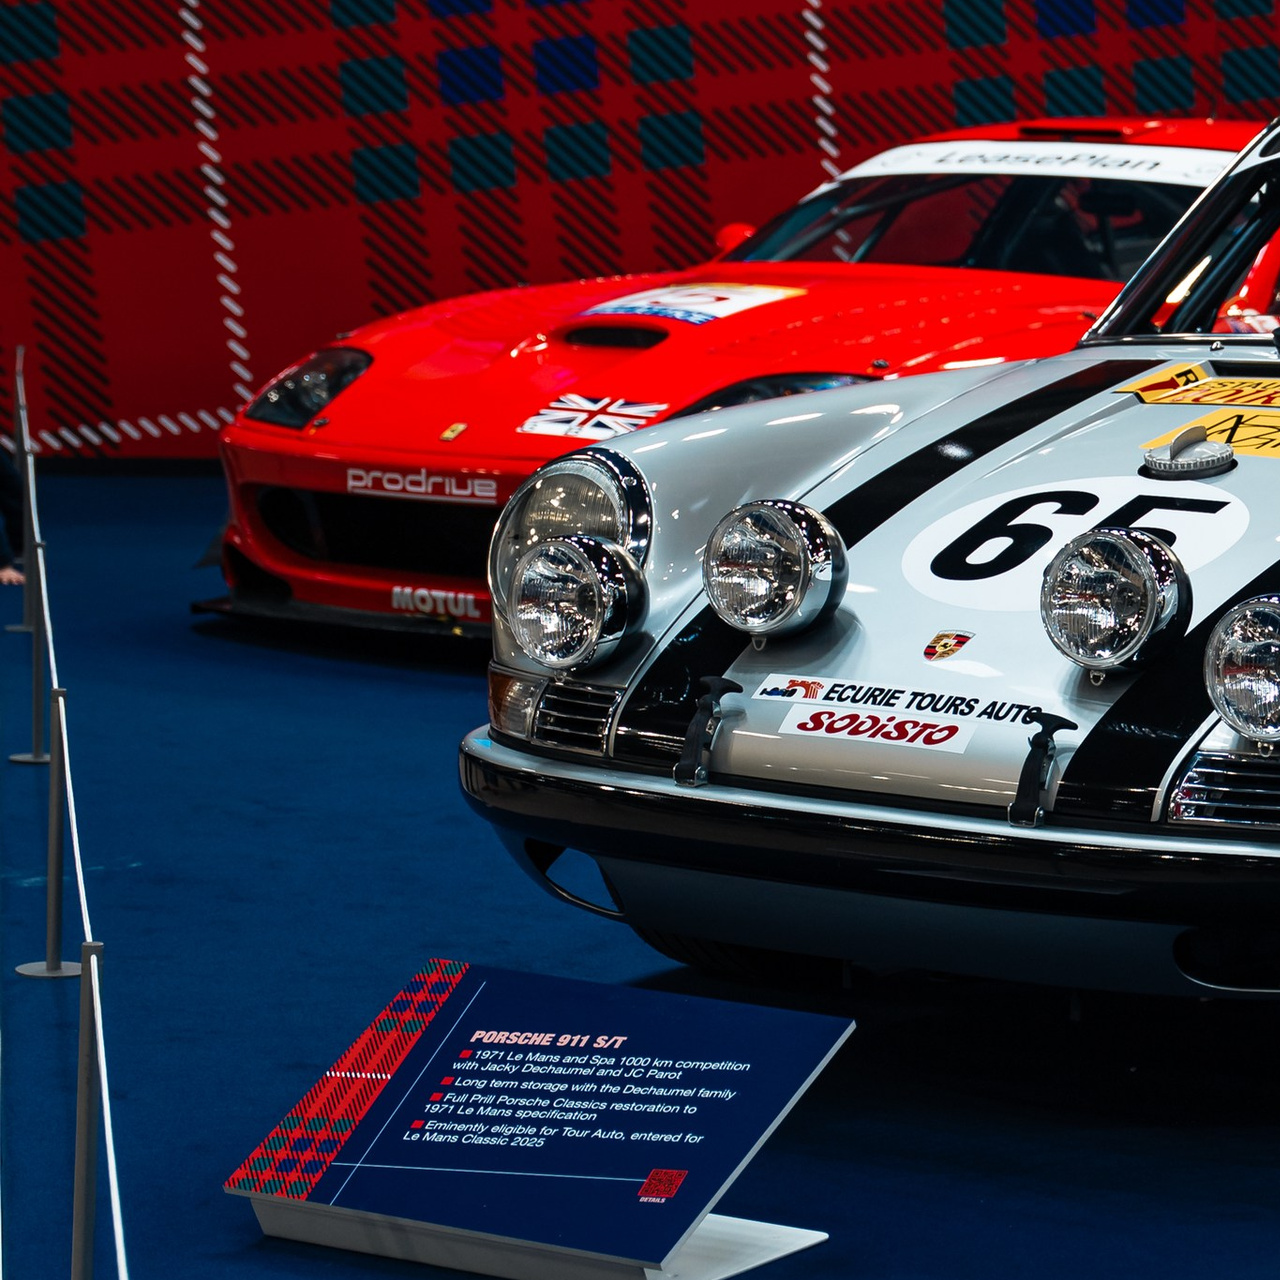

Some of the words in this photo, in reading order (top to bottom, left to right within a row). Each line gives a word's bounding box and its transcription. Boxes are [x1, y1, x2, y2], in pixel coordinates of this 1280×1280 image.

[936, 149, 1161, 171] LeasePlan
[347, 467, 497, 498] prodrive
[392, 586, 481, 618] MOTUL
[822, 683, 905, 708] ECURIE
[905, 691, 980, 716] TOURS
[977, 701, 1043, 725] AUTO
[470, 1030, 556, 1047] PORSCHE
[556, 1034, 590, 1047] 911
[593, 1035, 627, 1049] S/T
[452, 1060, 478, 1070] with
[480, 1062, 520, 1074] Jacky
[521, 1063, 594, 1076] Dechaumel
[596, 1068, 624, 1077] and
[624, 1068, 645, 1078] JC
[646, 1069, 683, 1080] Parot
[475, 1050, 505, 1060] 1971
[506, 1052, 523, 1061] Le
[525, 1052, 560, 1063] Mans
[562, 1054, 589, 1064] and
[589, 1055, 615, 1066] Spa
[620, 1057, 651, 1067] 1000
[652, 1058, 673, 1068] km
[675, 1060, 751, 1072] competition
[454, 1077, 487, 1089] Long
[489, 1080, 518, 1089] term
[520, 1082, 568, 1093] storage
[571, 1083, 597, 1093] with
[599, 1084, 621, 1094] the
[622, 1084, 697, 1097] Dechaumel
[697, 1088, 737, 1100] family
[424, 1104, 454, 1114] 1971
[456, 1105, 474, 1115] Le
[476, 1107, 513, 1117] Mans
[514, 1108, 597, 1121] specification
[443, 1093, 469, 1103] Full
[470, 1094, 496, 1105] Prill
[498, 1095, 550, 1107] Porsche
[553, 1098, 607, 1110] Classics
[609, 1102, 681, 1114] restoration
[683, 1105, 697, 1114] to
[403, 1131, 420, 1141] Le
[422, 1132, 459, 1143] Mans
[461, 1134, 509, 1146] Classic
[510, 1137, 546, 1148] 2025
[425, 1120, 489, 1135] Eminently
[490, 1123, 537, 1136] eligible
[539, 1125, 560, 1136] for
[562, 1127, 590, 1138] Tour
[590, 1129, 626, 1141] Auto,
[630, 1131, 683, 1143] entered
[684, 1133, 705, 1144] for
[639, 1196, 666, 1204] DETAILS
